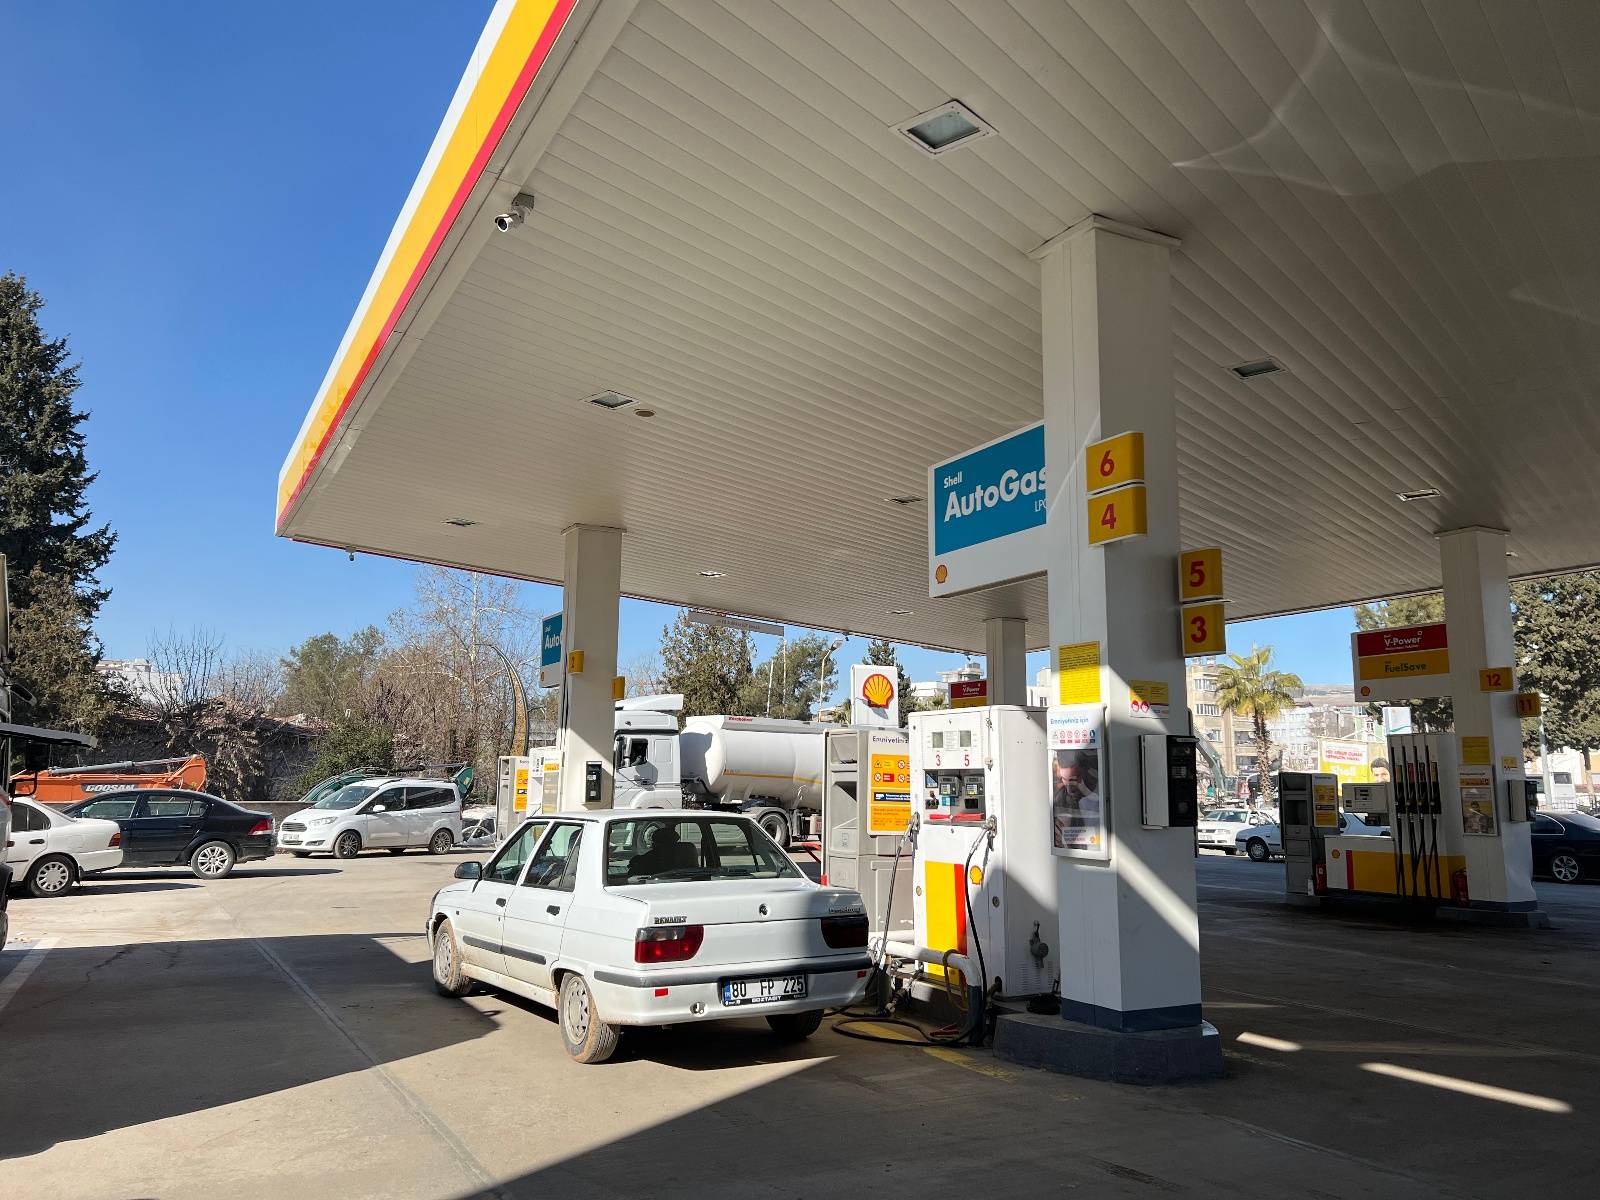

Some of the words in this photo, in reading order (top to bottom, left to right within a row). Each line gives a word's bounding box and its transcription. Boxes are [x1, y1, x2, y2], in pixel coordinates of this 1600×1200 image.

[1100, 450, 1115, 478] 6
[943, 471, 963, 488] Shell
[944, 466, 1048, 523] AutoGas
[1101, 502, 1117, 530] 4
[1189, 560, 1206, 588] 5
[1190, 616, 1207, 644] 3
[1384, 636, 1422, 647] V-Power
[1385, 662, 1427, 673] FuelSave
[1486, 673, 1502, 687] 12
[1520, 699, 1532, 711] 11
[935, 754, 942, 767] 3
[964, 754, 970, 767] 5
[654, 916, 688, 925] RENAULT
[732, 981, 747, 999] 80
[760, 979, 775, 996] FP
[782, 976, 804, 994] 225
